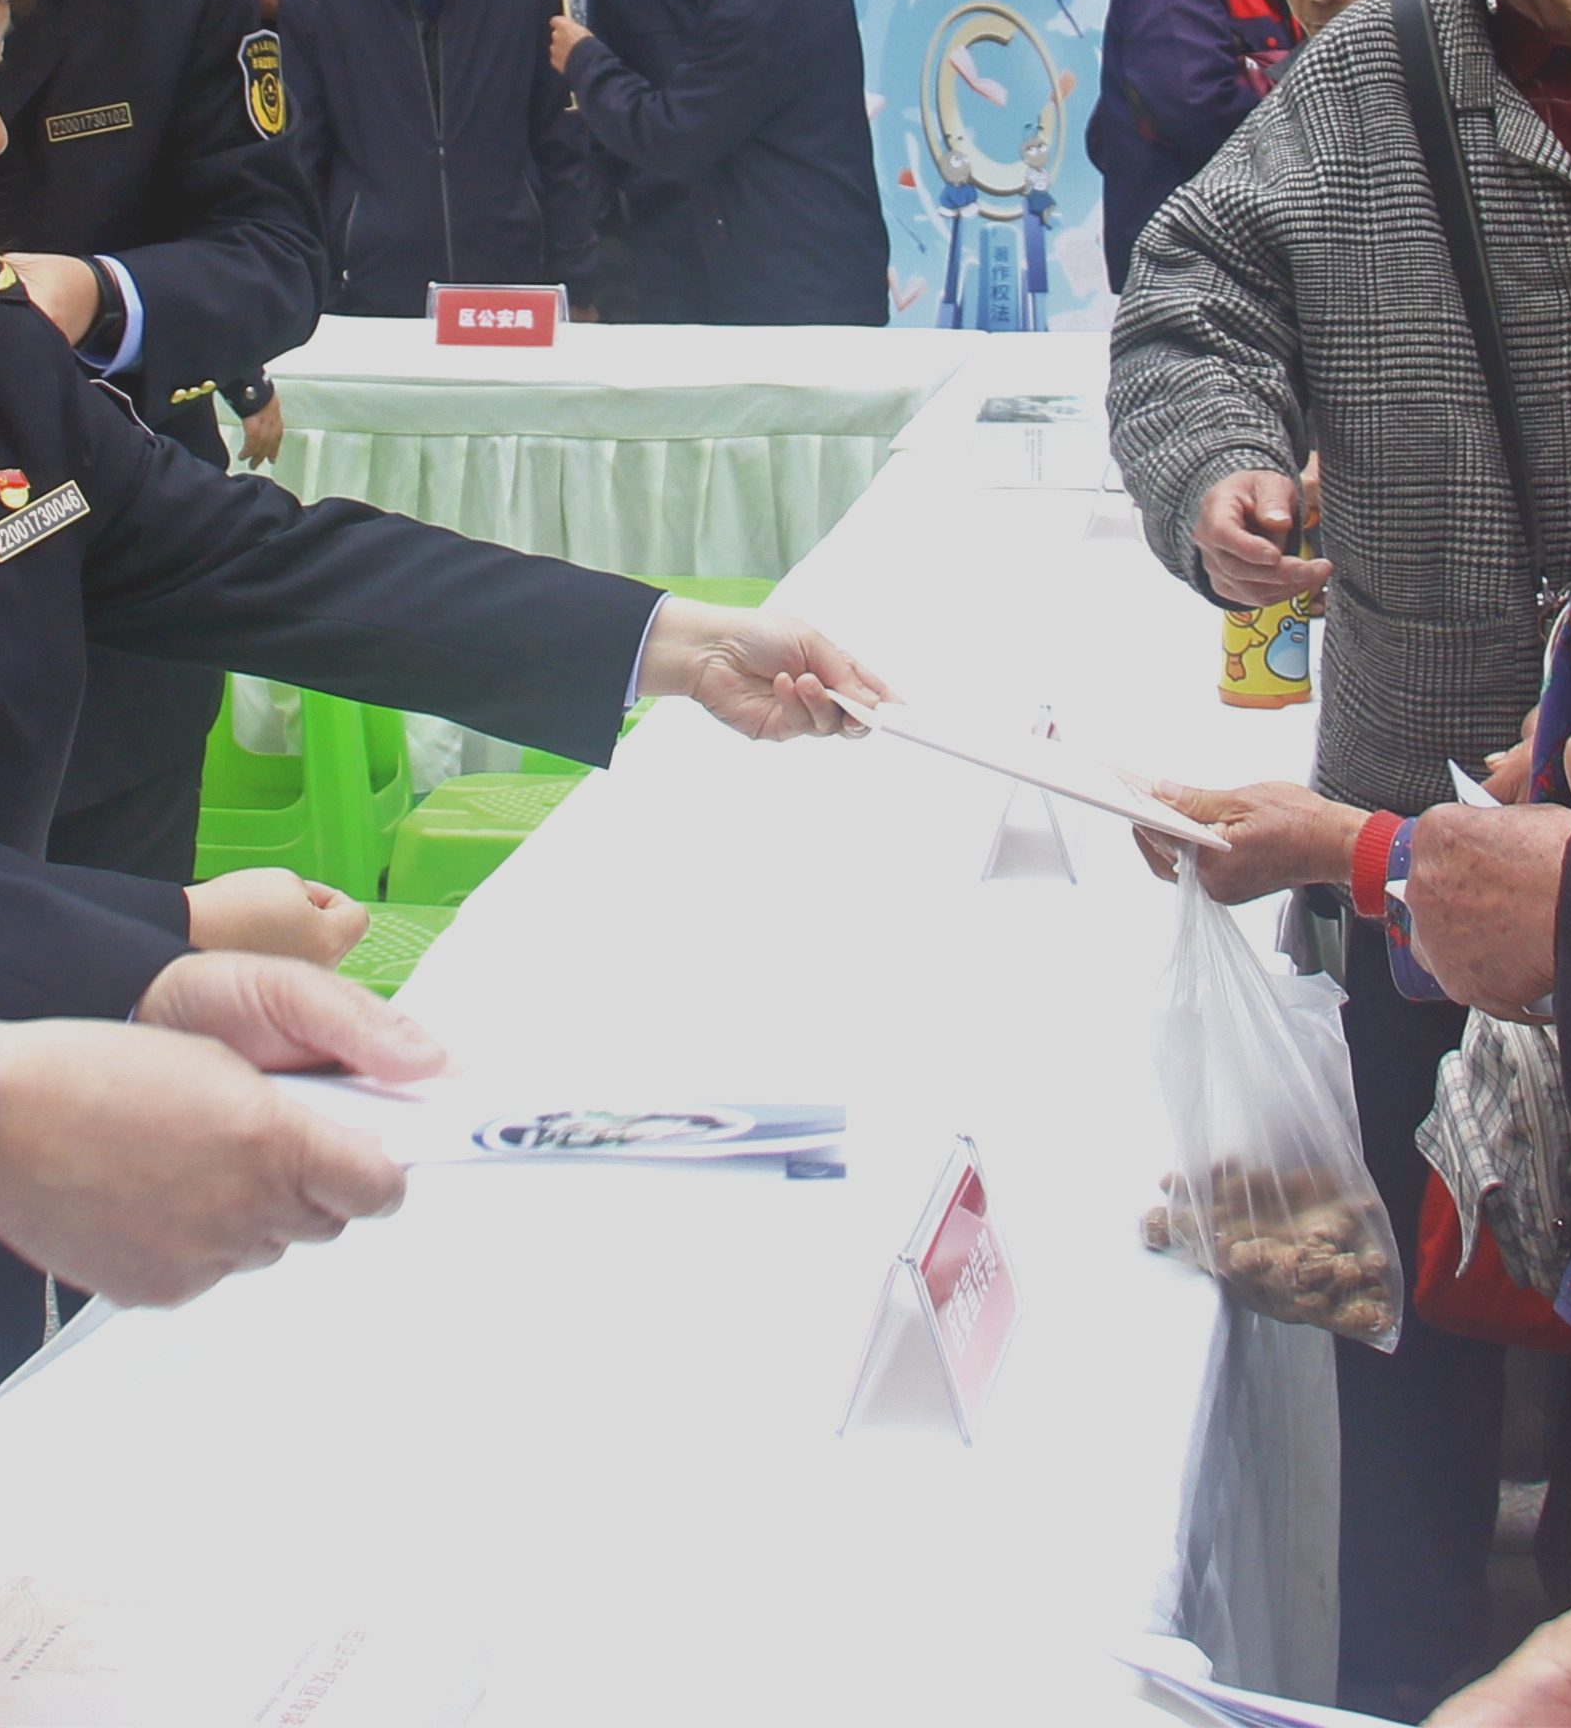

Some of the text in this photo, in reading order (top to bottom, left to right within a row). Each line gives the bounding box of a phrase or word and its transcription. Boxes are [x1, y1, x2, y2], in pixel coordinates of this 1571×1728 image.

[51, 107, 128, 136] 22001730102
[458, 308, 534, 329] 区公安局
[276, 1628, 369, 1728] 知识产权宣传读
